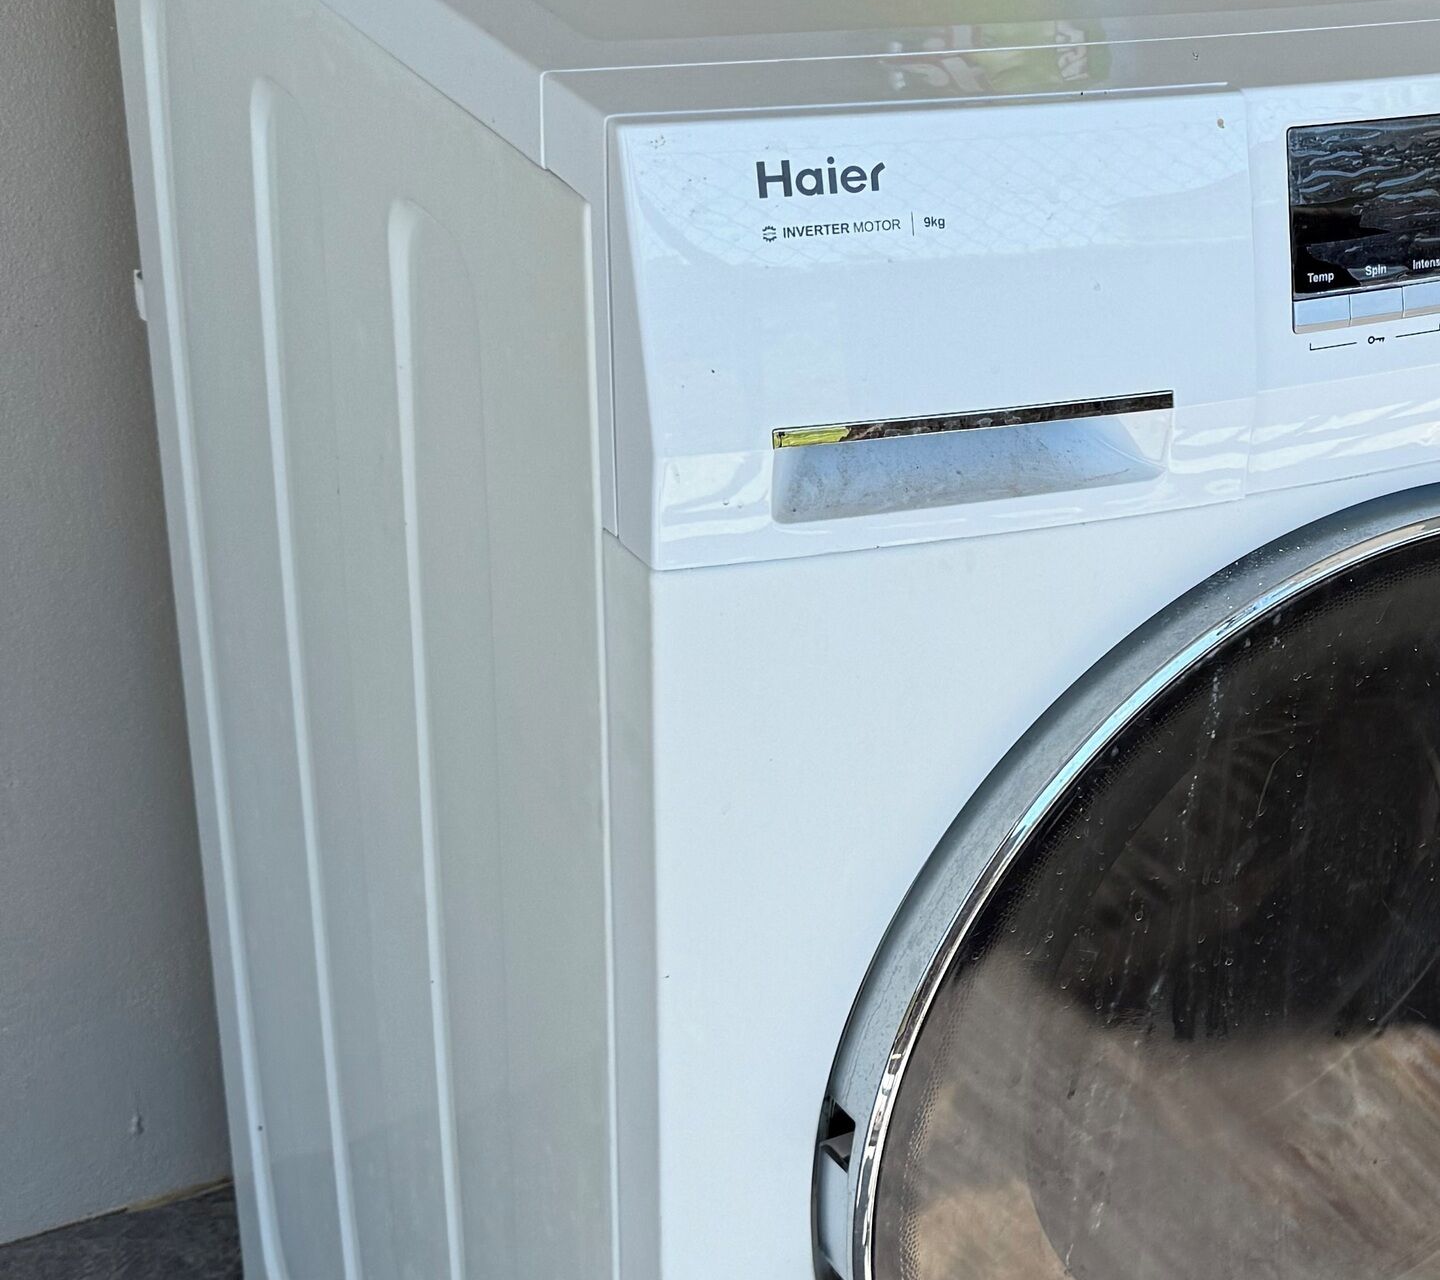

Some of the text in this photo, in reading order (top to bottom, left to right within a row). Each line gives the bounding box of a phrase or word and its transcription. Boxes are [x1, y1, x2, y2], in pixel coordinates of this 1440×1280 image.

[756, 156, 886, 199] Haier
[782, 216, 946, 239] INVERTER MOTOR 9kg
[1307, 272, 1335, 284] Temp
[1365, 264, 1387, 276] Spin
